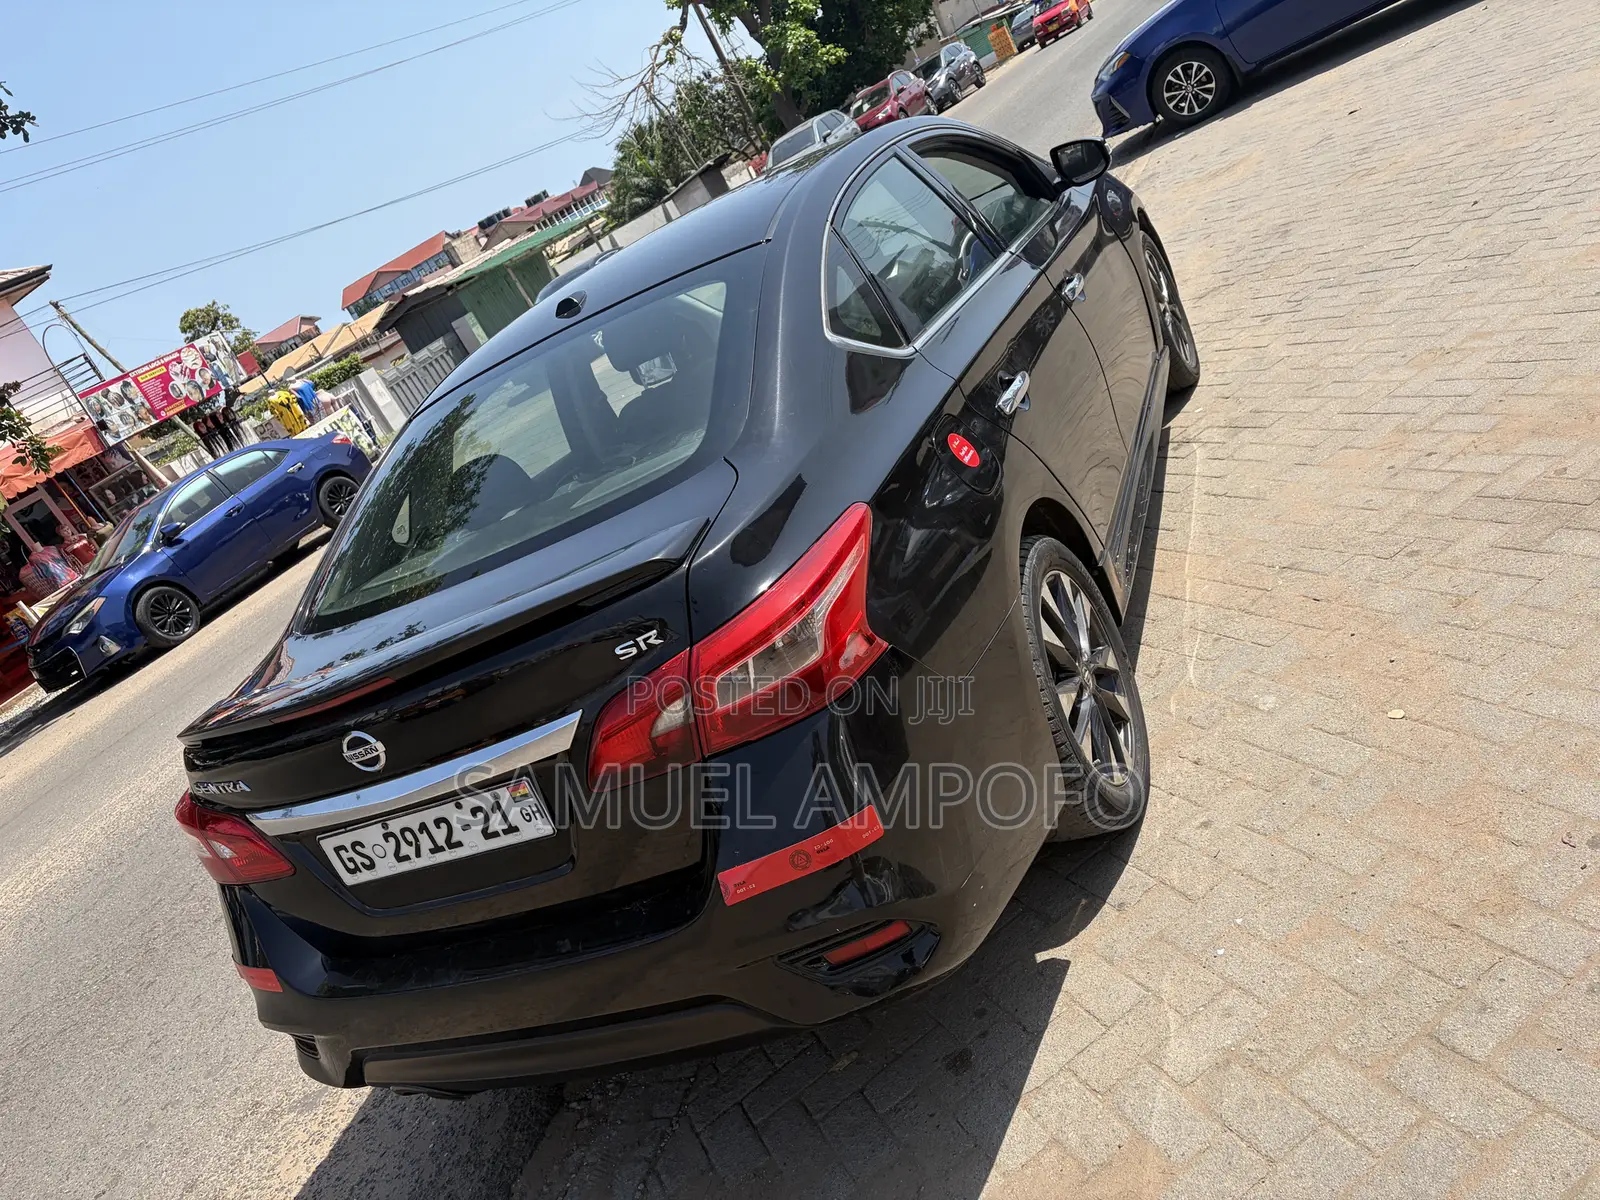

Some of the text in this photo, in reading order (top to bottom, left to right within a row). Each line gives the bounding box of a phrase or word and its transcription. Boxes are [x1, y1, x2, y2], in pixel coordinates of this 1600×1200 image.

[615, 630, 664, 660] SR
[345, 744, 380, 762] NISSAN
[194, 780, 252, 795] SENTRA
[519, 802, 546, 823] GH
[333, 840, 376, 875] GS
